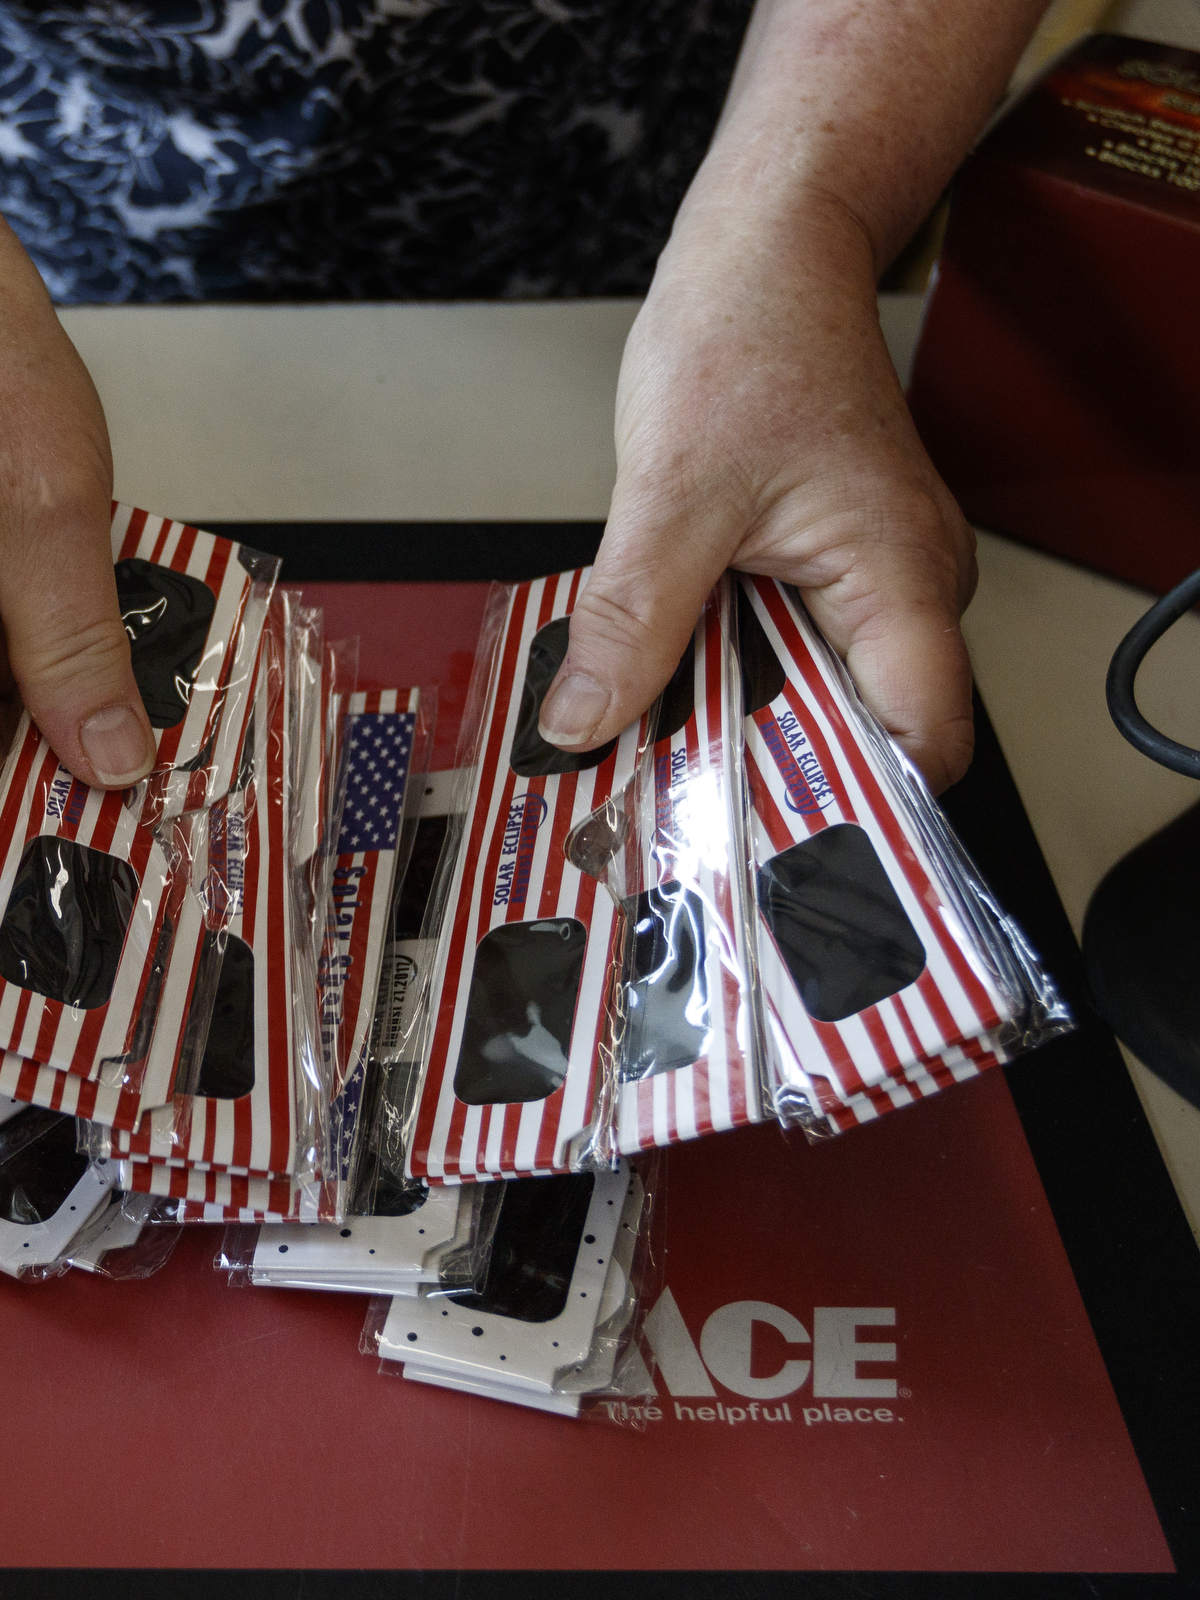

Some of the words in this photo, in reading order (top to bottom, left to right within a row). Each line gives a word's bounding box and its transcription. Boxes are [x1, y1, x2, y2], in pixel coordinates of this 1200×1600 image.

[777, 711, 807, 752] SOLAR
[796, 751, 833, 802] ECLIPSE
[46, 779, 72, 819] SOLAR
[502, 803, 525, 855] ECLIPSE
[323, 865, 367, 941] Solar
[493, 861, 515, 906] SOLAR
[609, 1285, 899, 1399] ACE
[600, 1401, 662, 1422] The
[674, 1401, 792, 1425] helpful
[802, 1401, 905, 1427] place.
